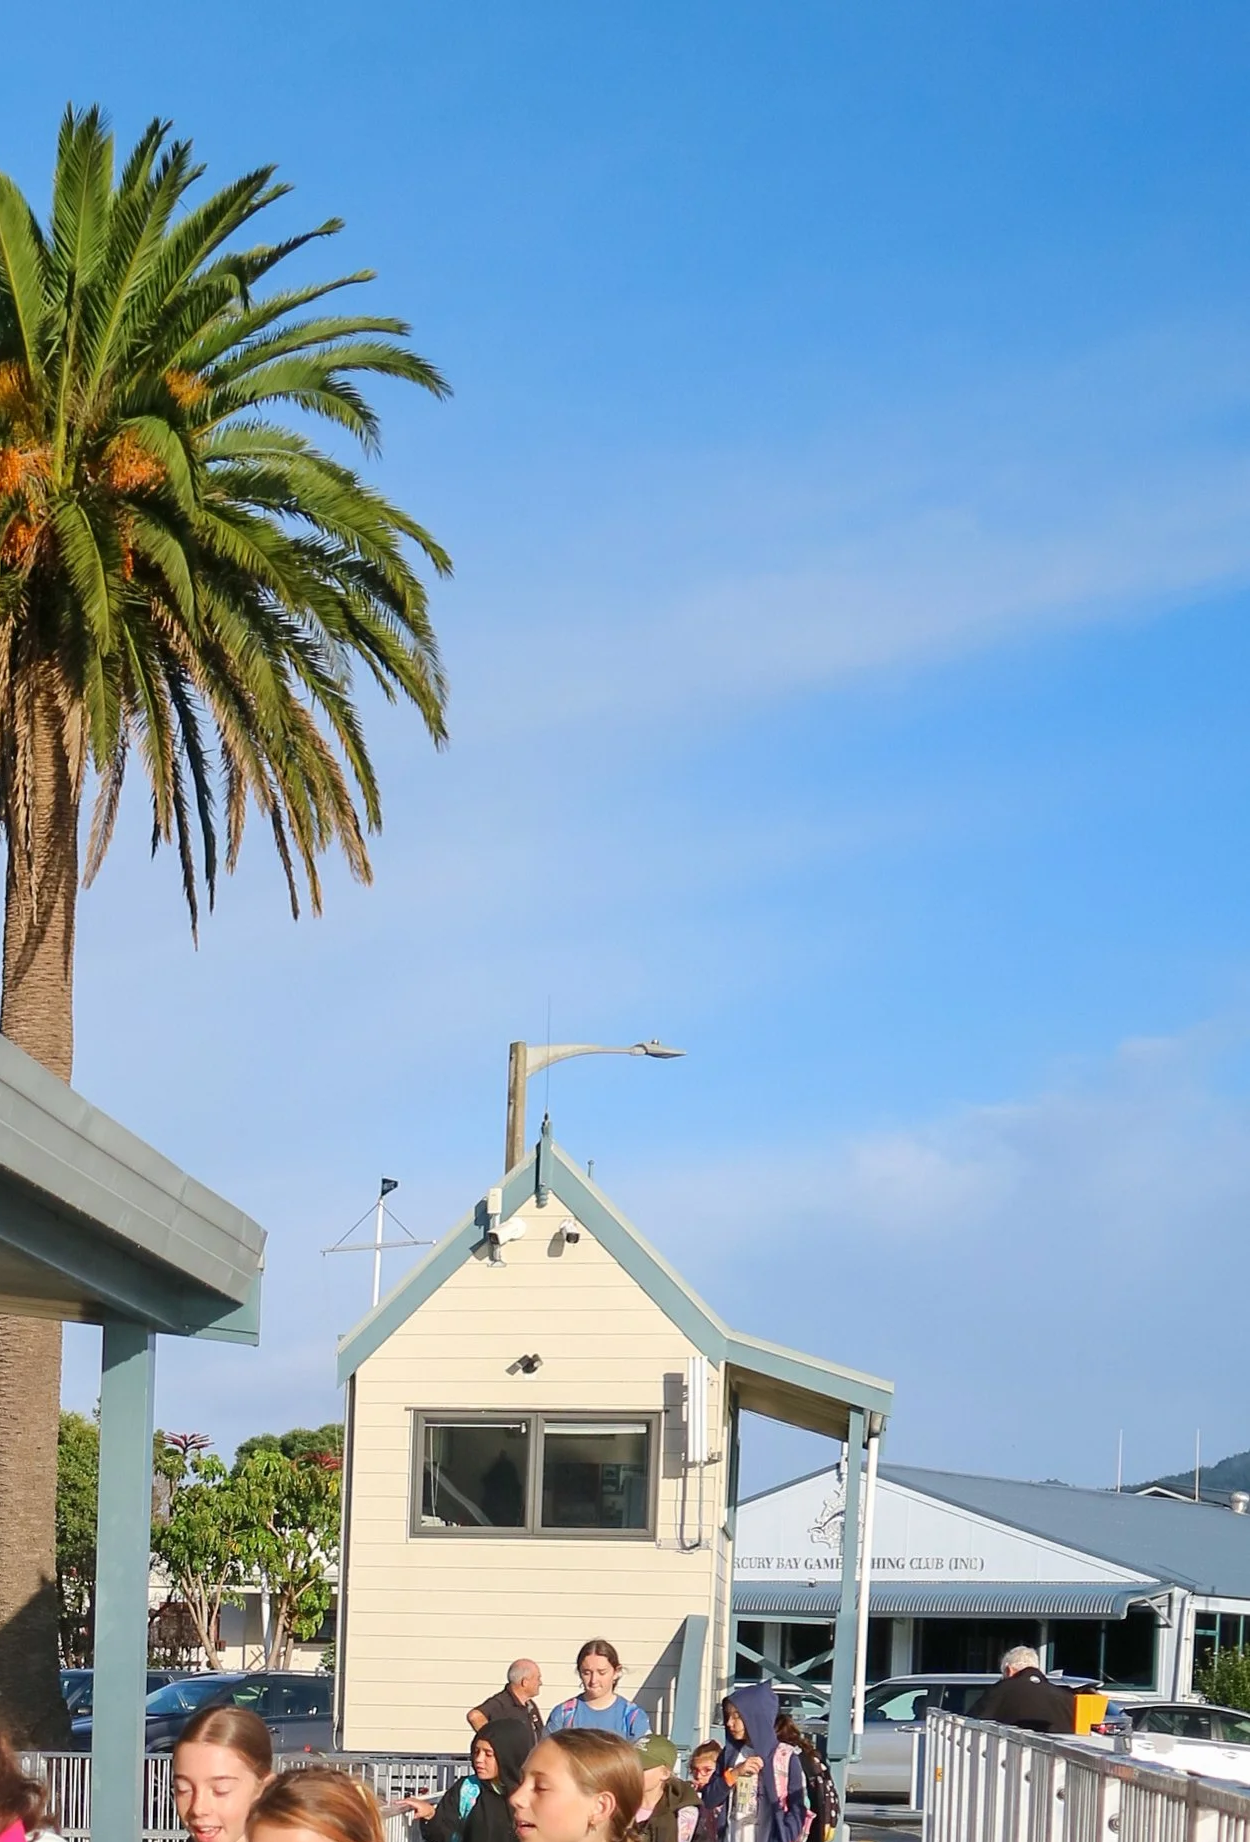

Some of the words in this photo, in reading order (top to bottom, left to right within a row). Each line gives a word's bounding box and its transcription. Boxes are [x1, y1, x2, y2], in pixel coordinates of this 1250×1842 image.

[733, 1557, 774, 1569] RCURY
[776, 1557, 801, 1569] BAY
[804, 1557, 843, 1570] GAME
[909, 1557, 944, 1570] CLUB
